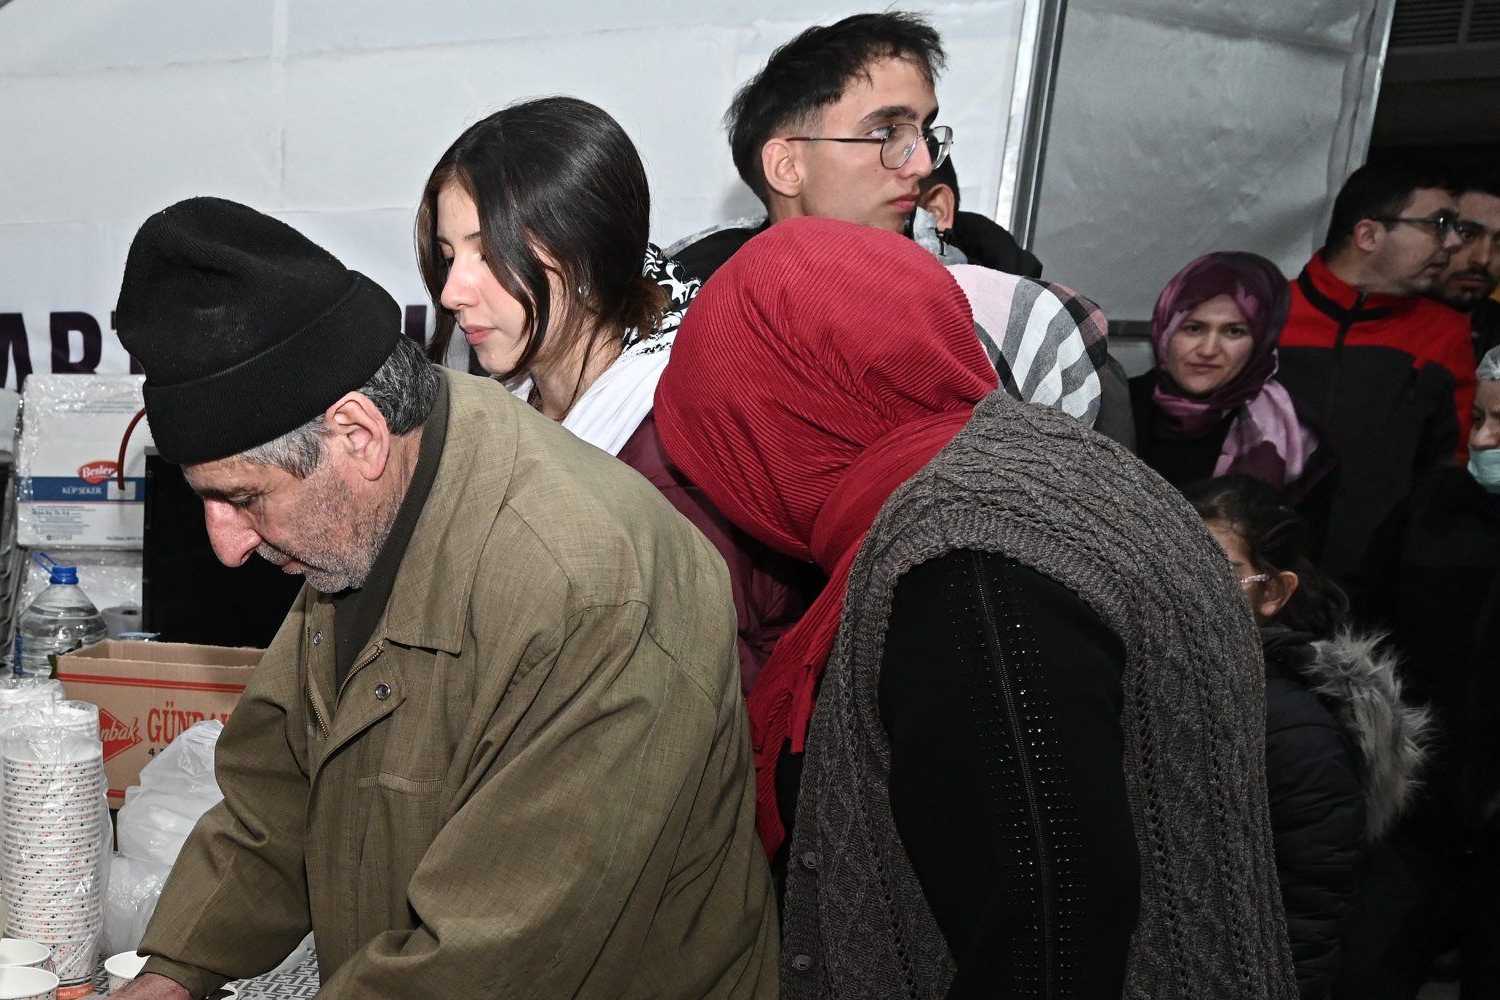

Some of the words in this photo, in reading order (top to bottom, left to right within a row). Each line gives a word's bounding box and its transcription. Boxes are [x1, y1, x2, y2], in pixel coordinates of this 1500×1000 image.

[82, 465, 115, 478] Besler
[100, 716, 141, 744] nbak
[147, 701, 230, 744] GÜN
